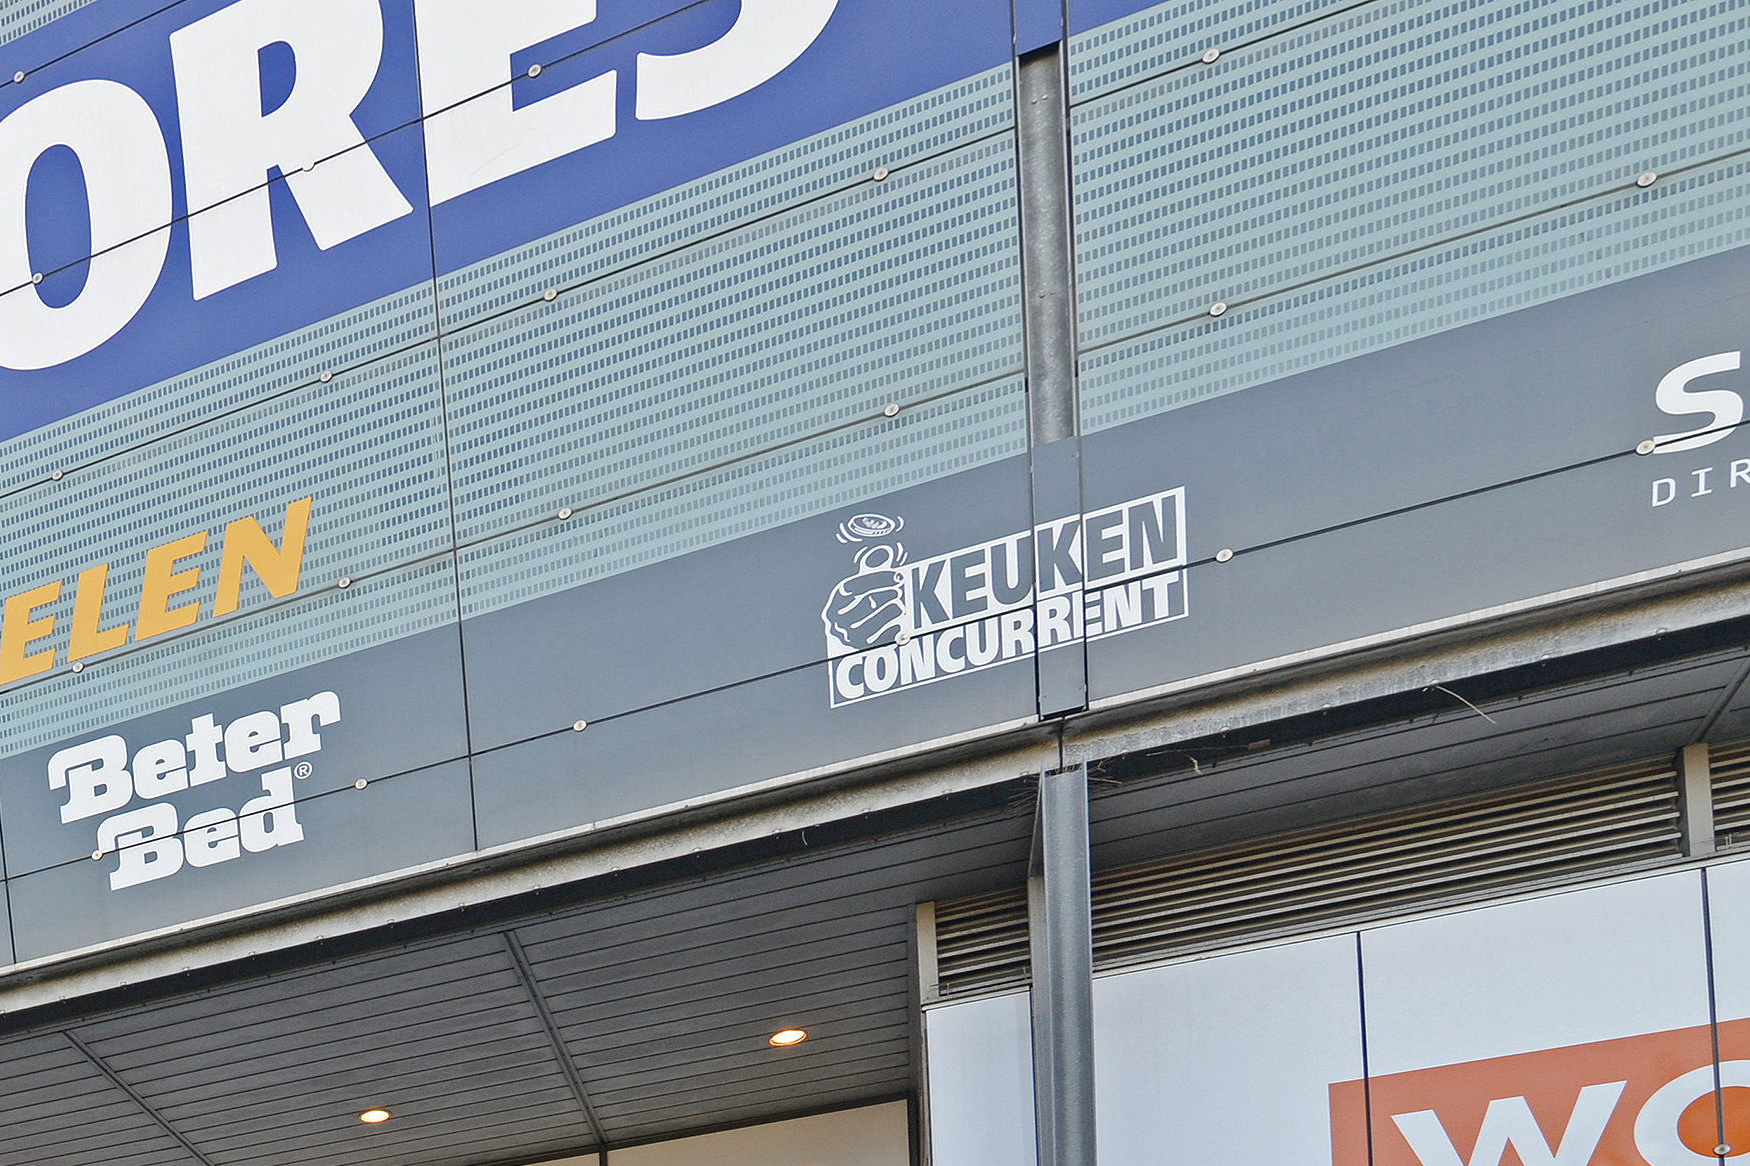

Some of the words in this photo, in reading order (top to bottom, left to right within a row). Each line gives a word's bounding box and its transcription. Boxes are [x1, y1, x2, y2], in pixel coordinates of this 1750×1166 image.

[1652, 458, 1750, 507] DIR
[907, 493, 1180, 632] KEUKEN
[834, 570, 1182, 697] CONCURRENT
[47, 691, 340, 824] Beter
[94, 768, 304, 891] Bed
